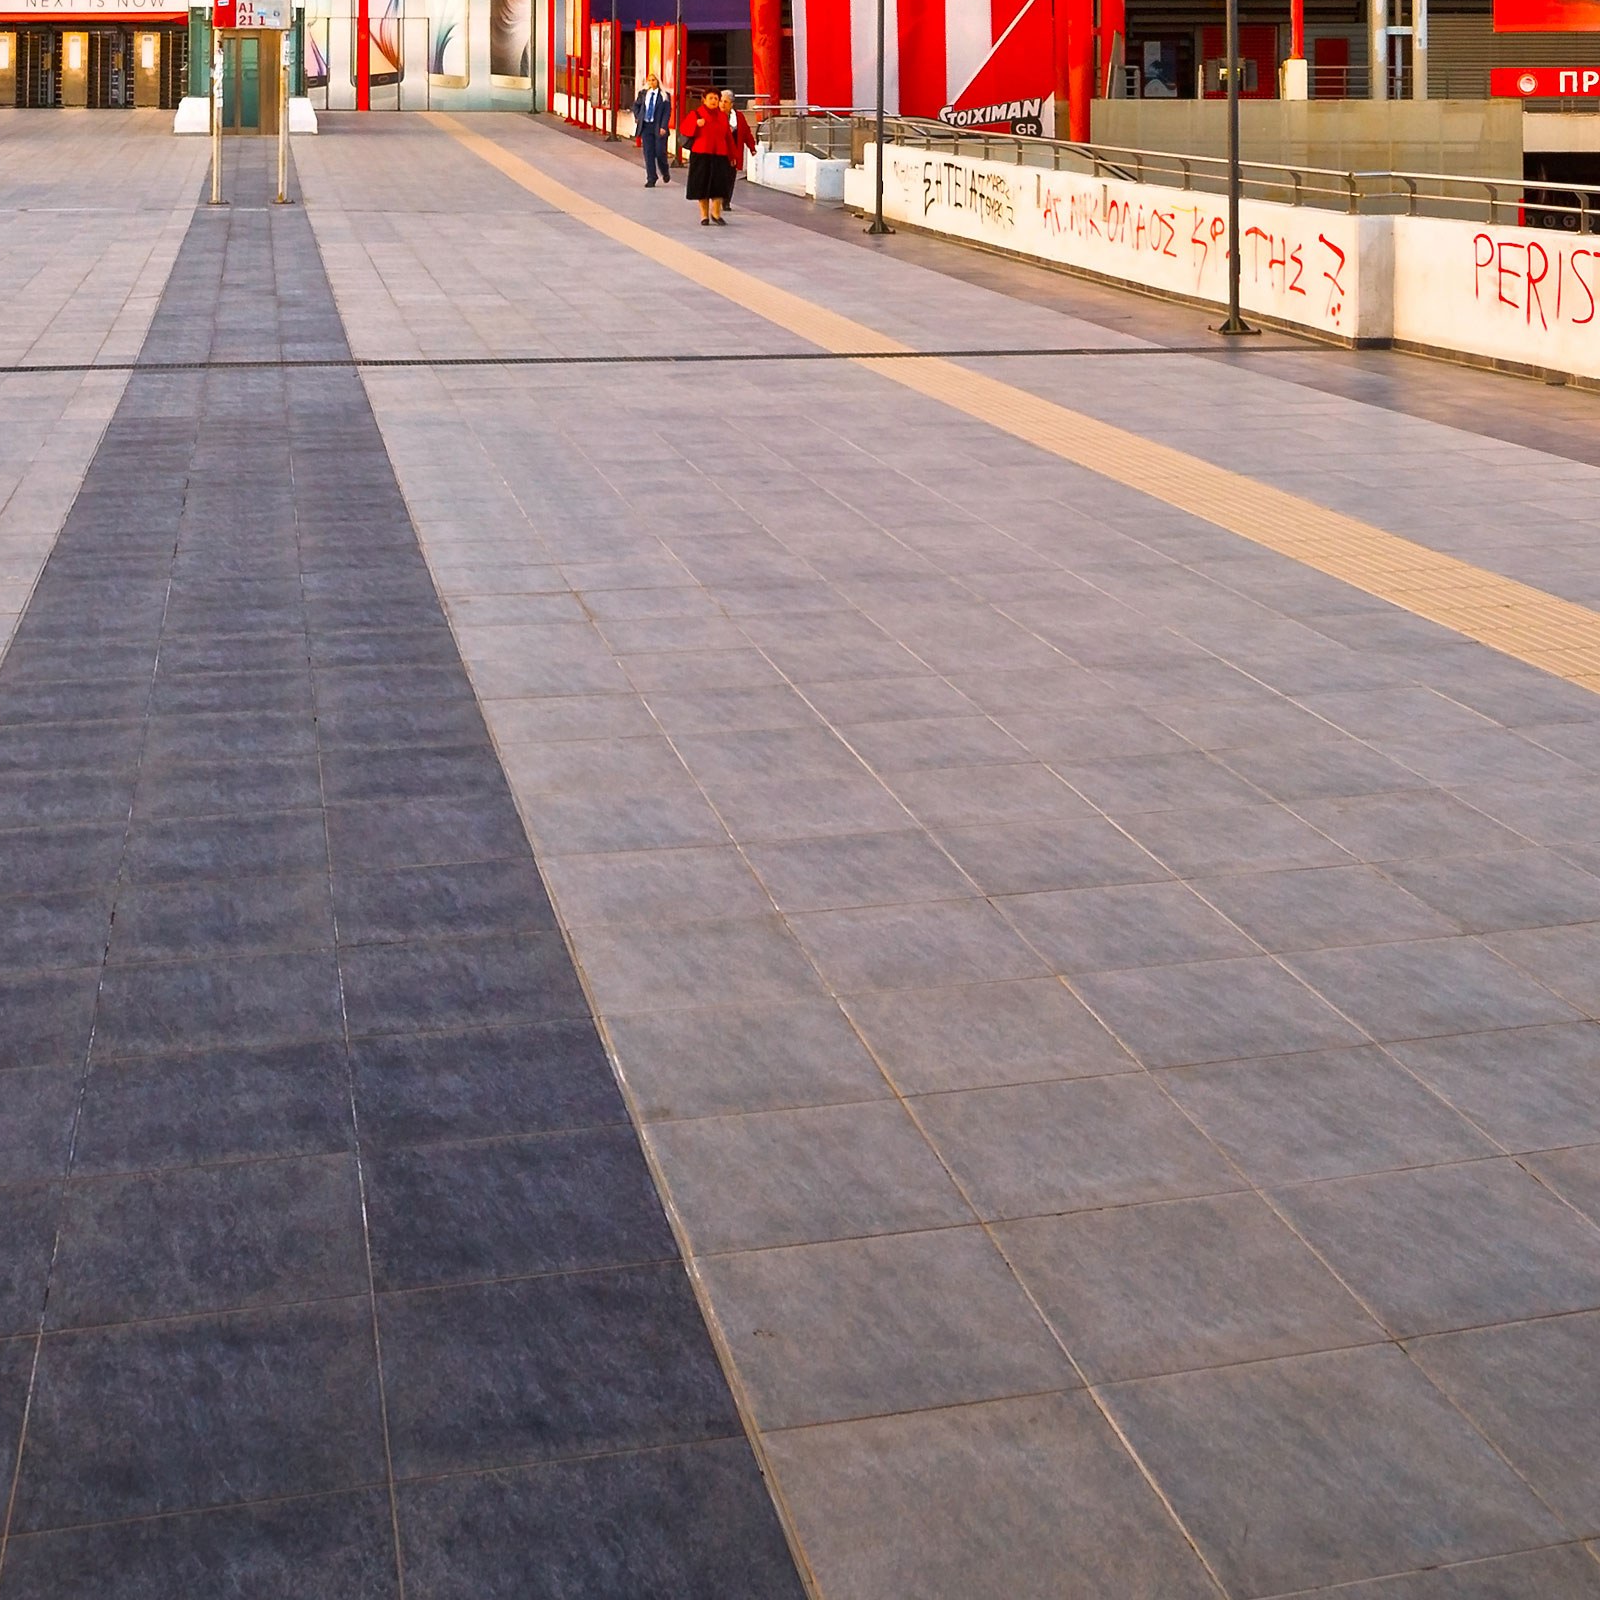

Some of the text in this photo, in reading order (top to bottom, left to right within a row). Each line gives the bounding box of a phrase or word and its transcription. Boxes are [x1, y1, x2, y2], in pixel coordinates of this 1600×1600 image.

[239, 3, 254, 13] A1
[939, 98, 1041, 126] STOIXIMAN
[1016, 124, 1037, 135] GR
[1191, 206, 1307, 296] ΚΡΤΗΣ
